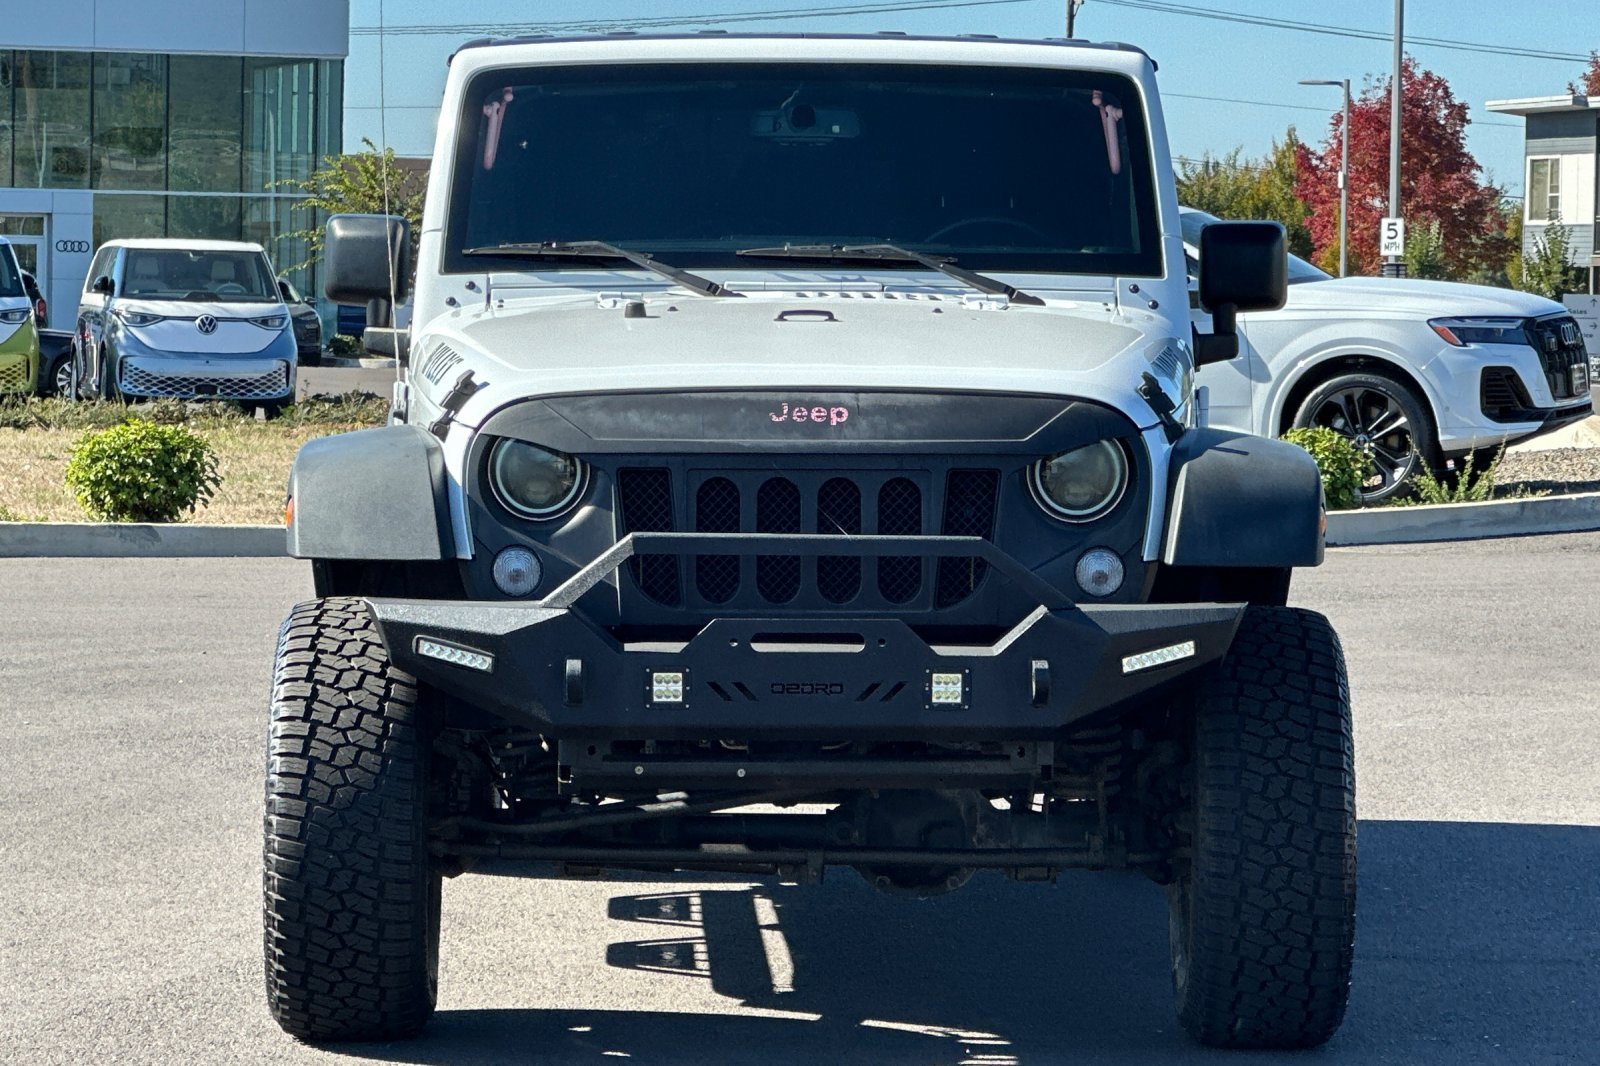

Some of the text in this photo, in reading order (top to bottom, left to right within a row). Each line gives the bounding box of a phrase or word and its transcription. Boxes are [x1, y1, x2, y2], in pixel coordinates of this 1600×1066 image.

[1386, 222, 1398, 240] 5
[1383, 241, 1400, 251] MPH
[769, 402, 849, 426] Jeep
